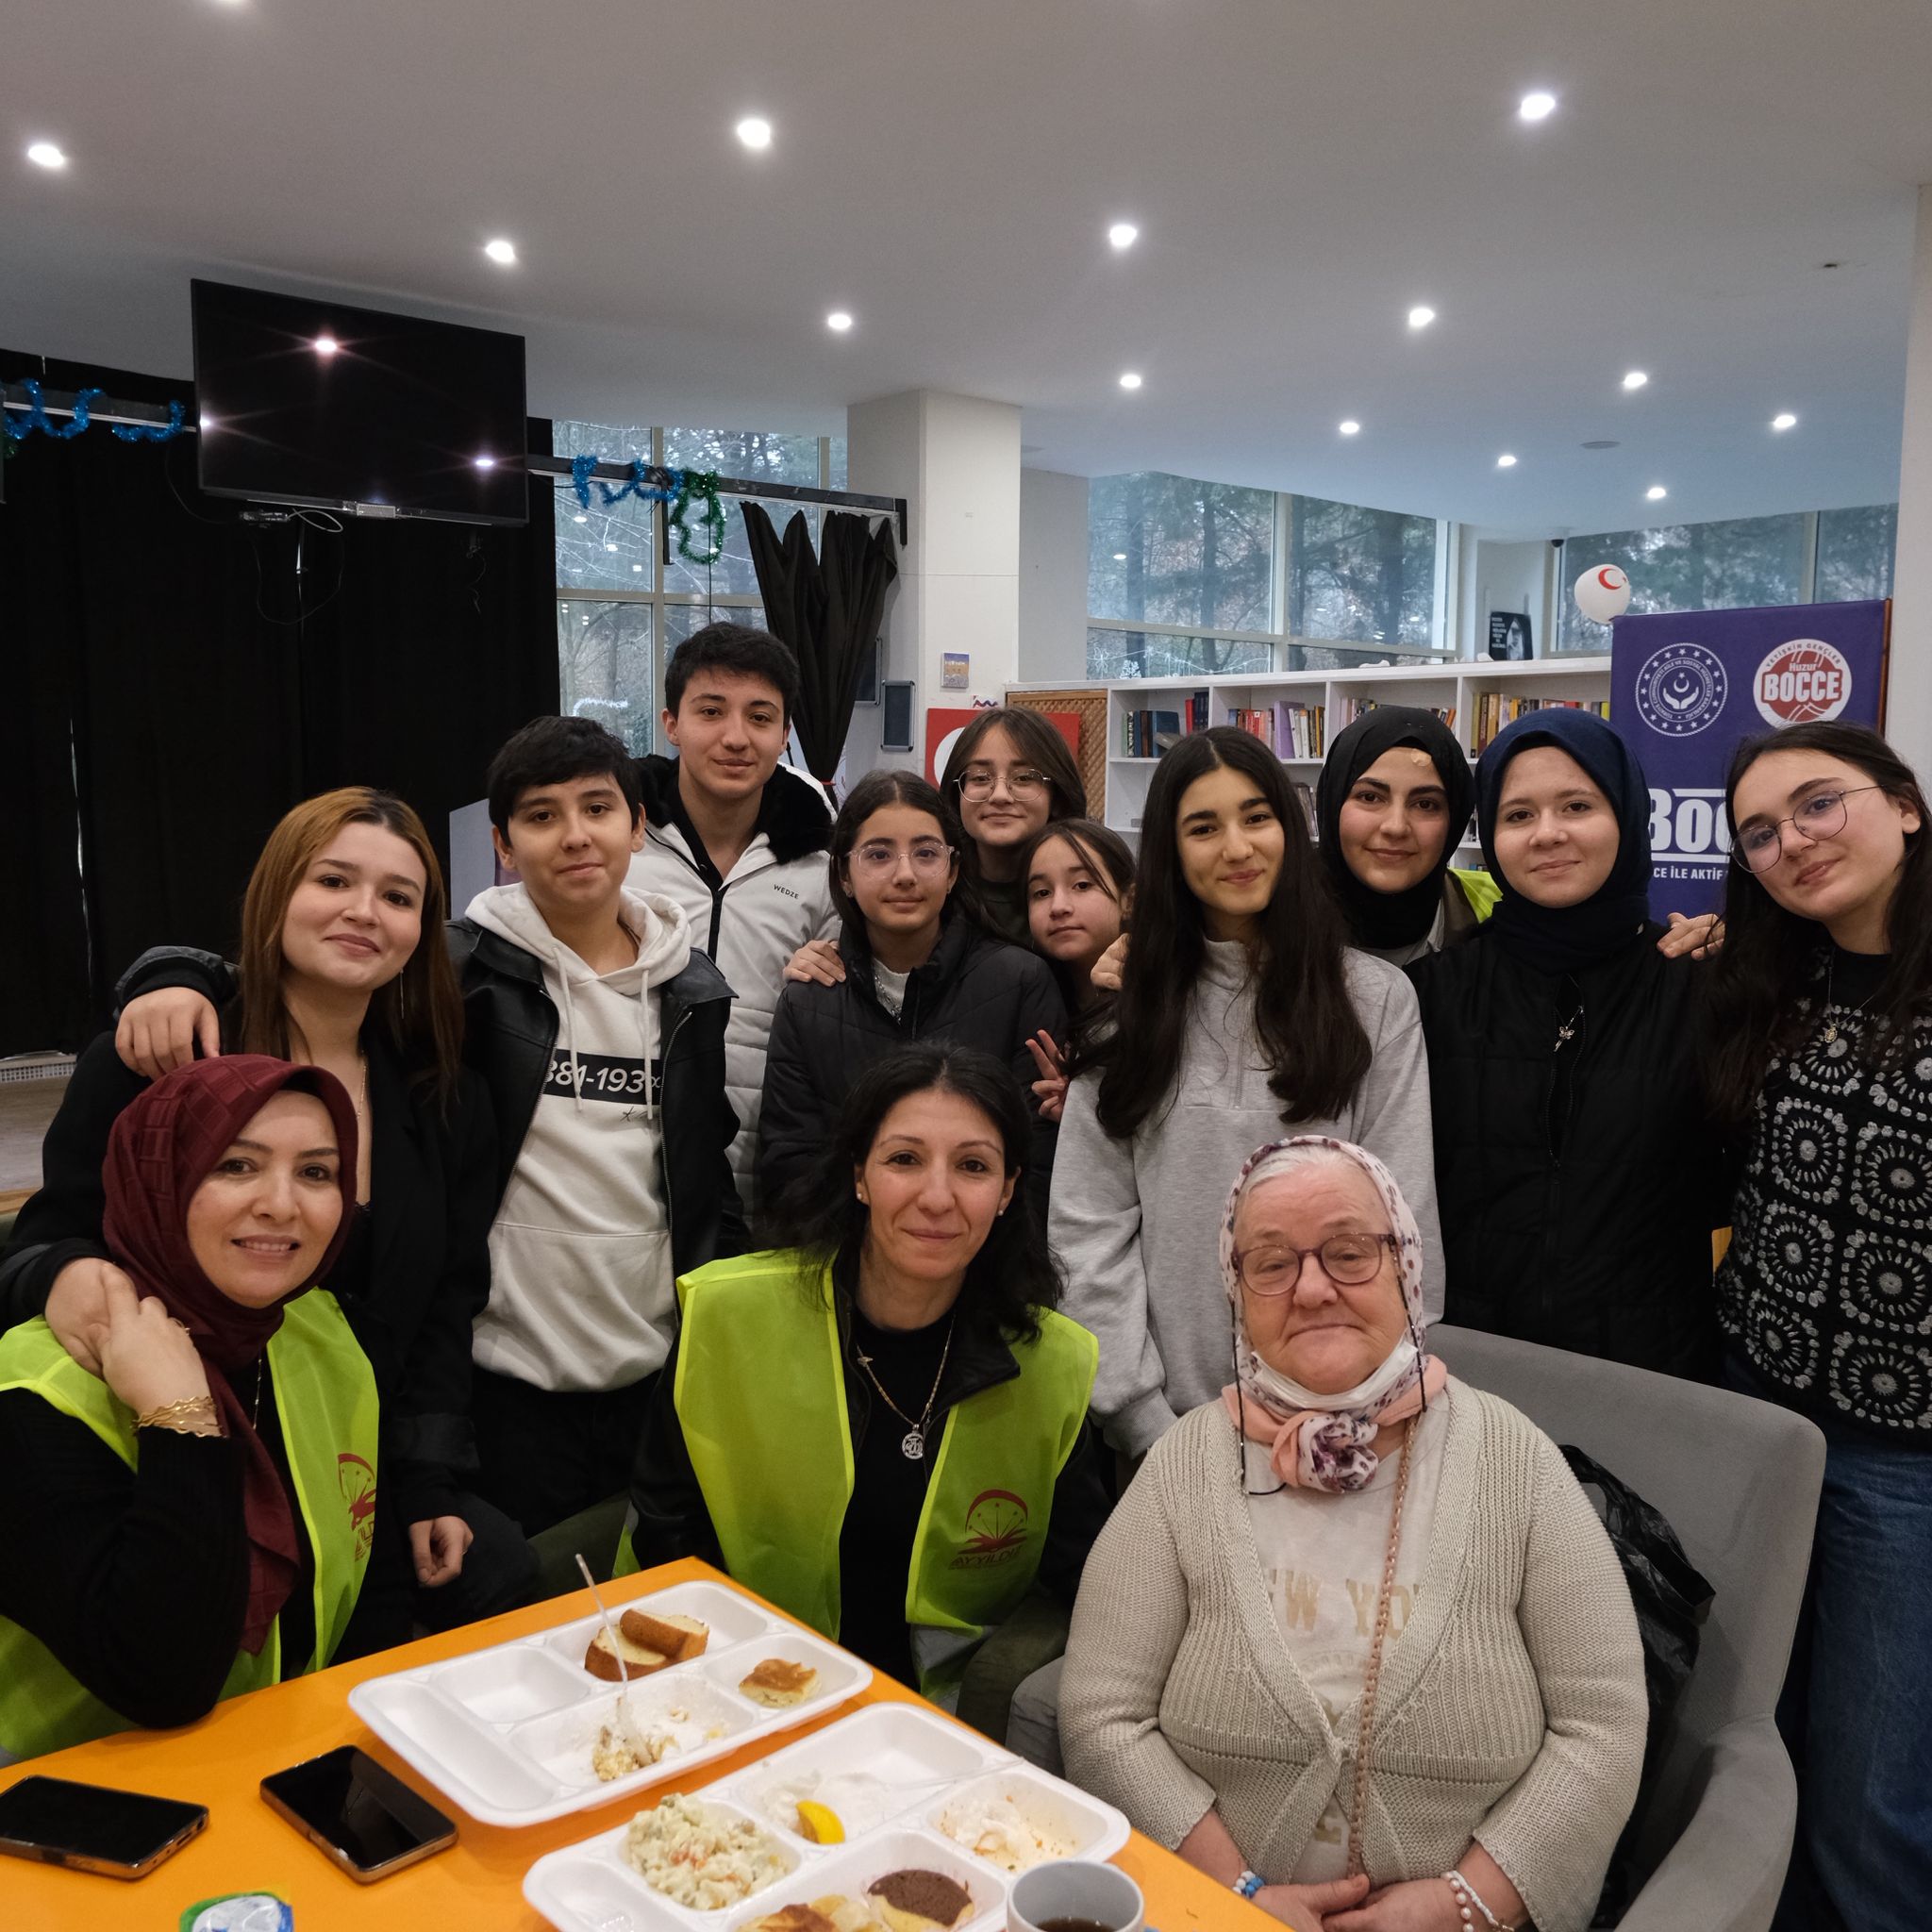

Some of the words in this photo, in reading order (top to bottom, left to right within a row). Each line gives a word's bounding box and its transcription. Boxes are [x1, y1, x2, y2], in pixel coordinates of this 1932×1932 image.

[1763, 670, 1841, 703] BOCCE
[1670, 865, 1688, 879] İLE
[1690, 867, 1724, 880] AKTİF
